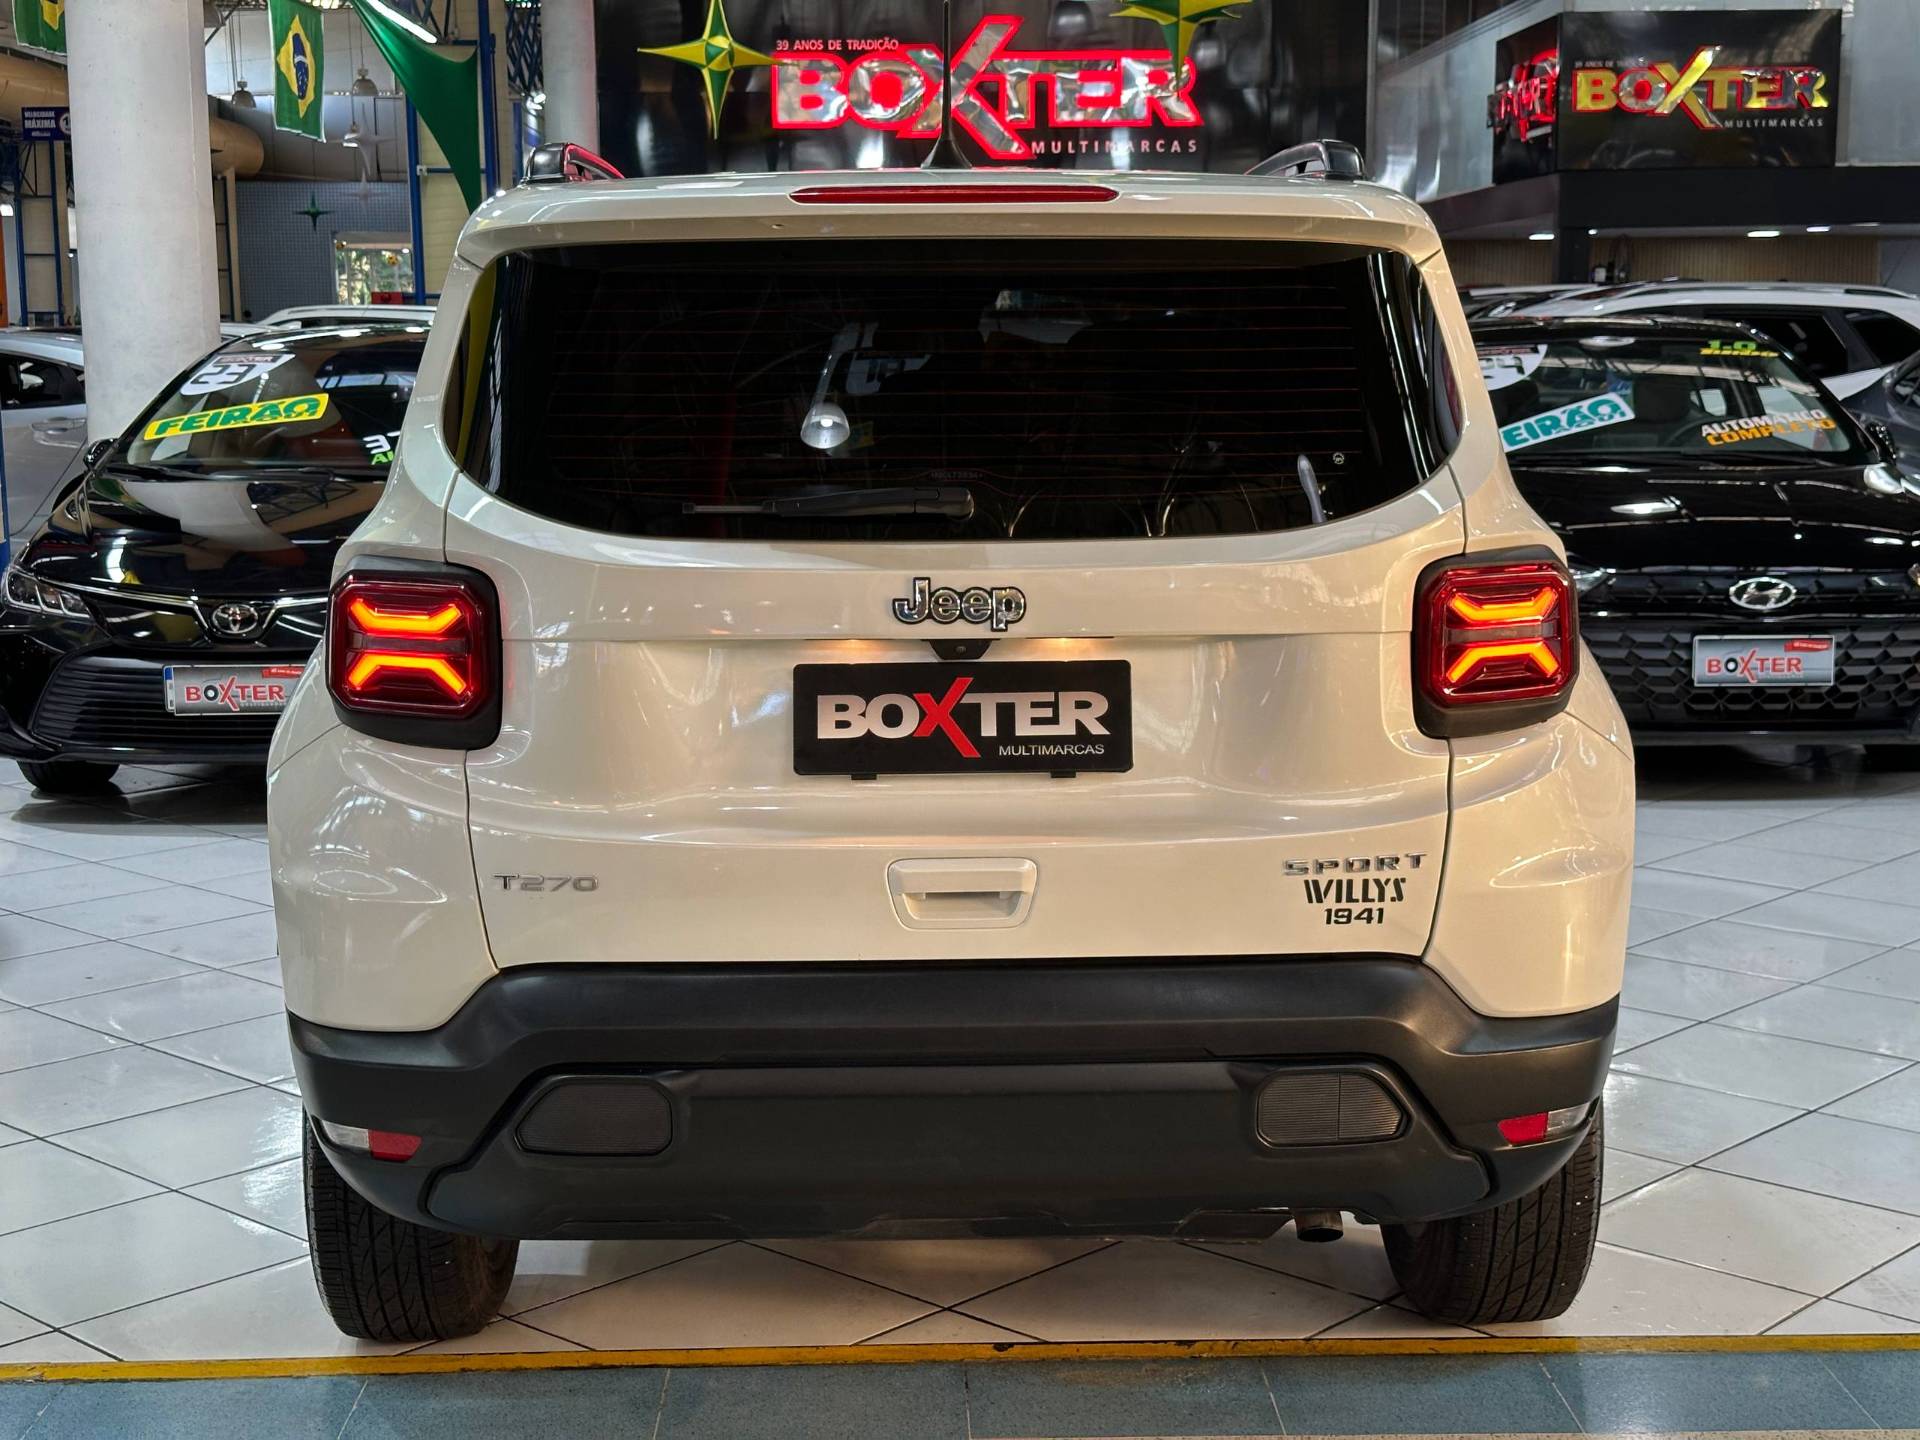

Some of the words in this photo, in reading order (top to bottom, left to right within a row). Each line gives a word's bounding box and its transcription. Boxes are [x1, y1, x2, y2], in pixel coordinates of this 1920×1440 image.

[776, 39, 789, 50] 39
[793, 39, 823, 50] ANOS
[827, 39, 842, 50] DE
[847, 36, 899, 51] TRADIÇÃO
[771, 15, 1203, 160] BOXTER
[1572, 45, 1829, 130] BOXTER
[24, 118, 56, 128] MÁXIMA
[1724, 118, 1825, 128] MULTIMARCAS
[1031, 139, 1198, 154] MULTIMARCAS
[154, 397, 321, 436] FEIRÃO
[1501, 399, 1627, 447] EIRÃO
[892, 577, 1027, 632] Jeep
[1705, 648, 1804, 684] BOXTER
[184, 675, 287, 712] BOXTER
[816, 677, 1112, 758] BOXTER
[998, 744, 1105, 756] MULTIMARCAS
[1283, 852, 1428, 876] SPORT
[493, 873, 600, 892] T270
[1304, 877, 1407, 904] WILLYS
[1324, 907, 1385, 925] 1941
